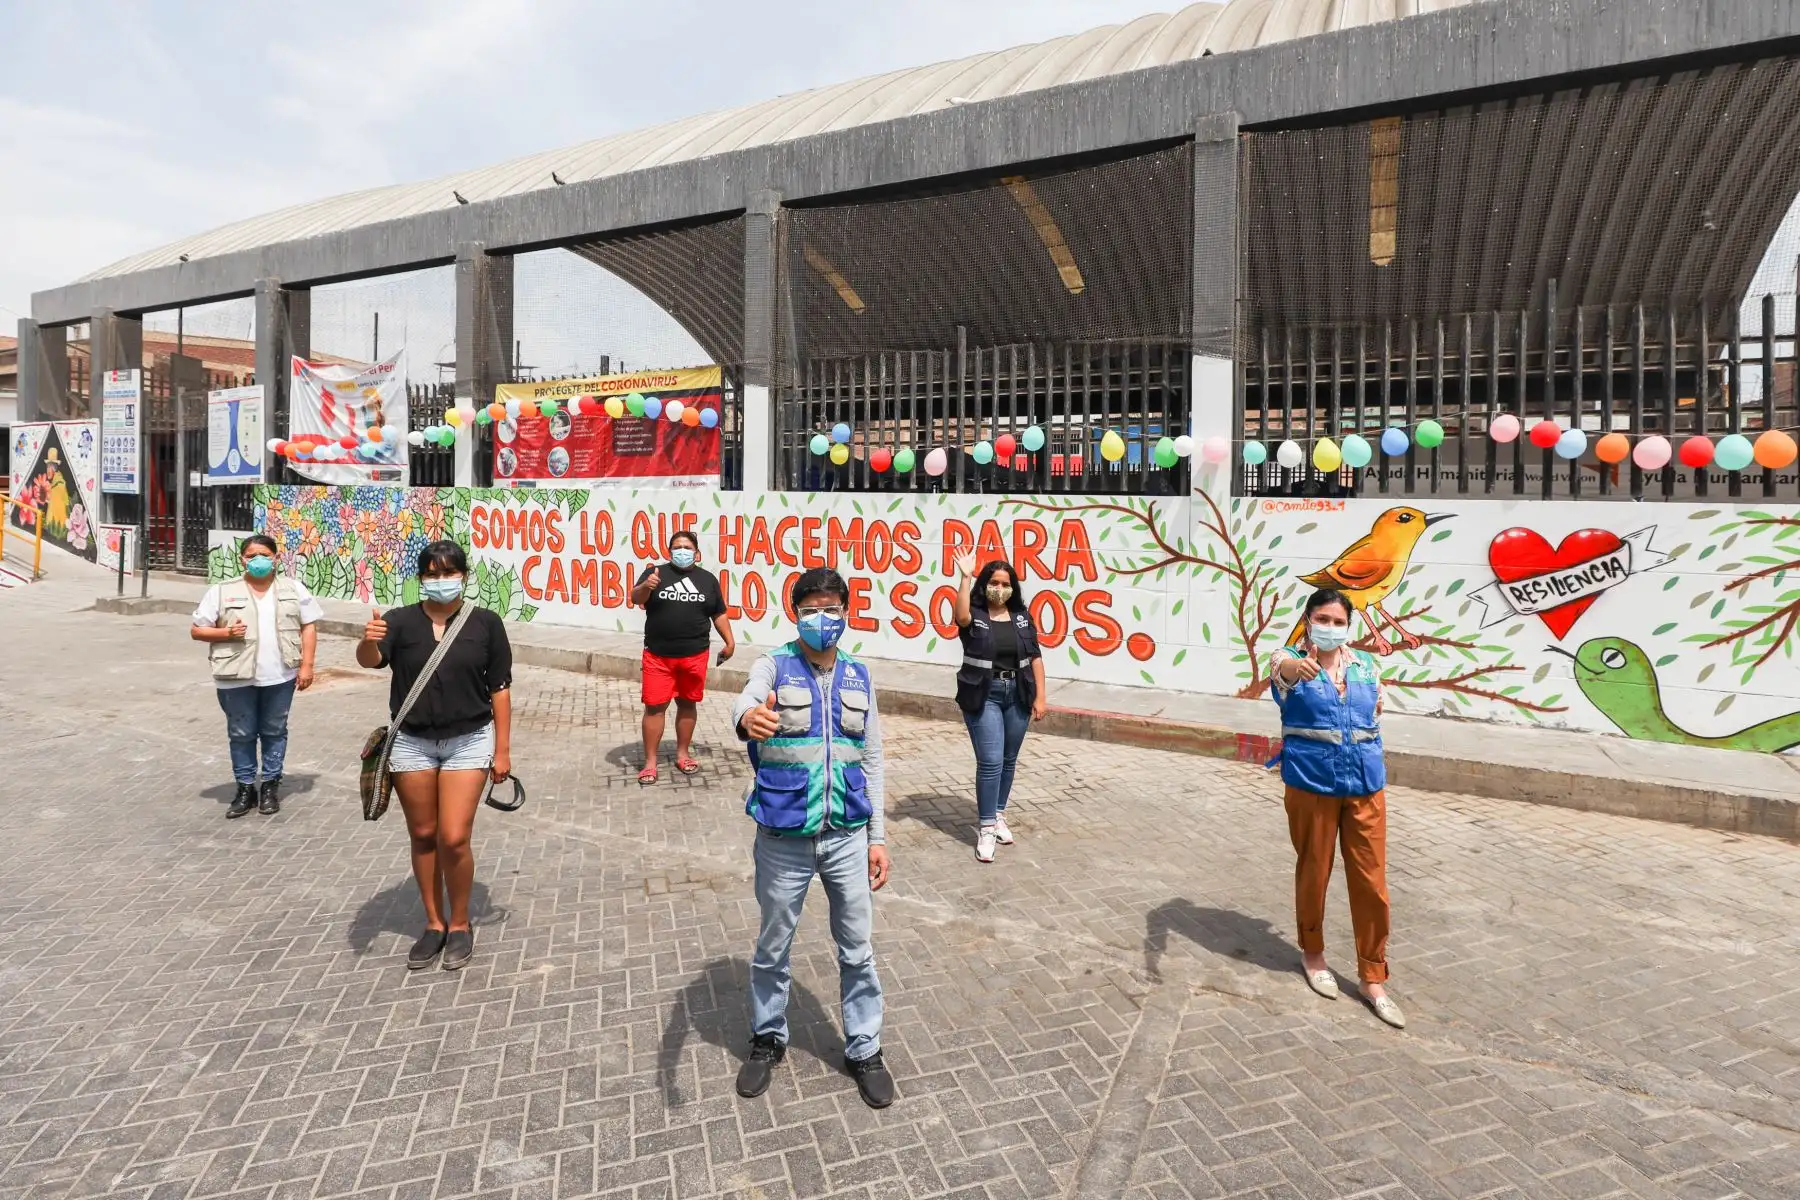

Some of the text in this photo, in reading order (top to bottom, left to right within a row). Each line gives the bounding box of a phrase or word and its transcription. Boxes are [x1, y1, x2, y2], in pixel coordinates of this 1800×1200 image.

[584, 382, 600, 393] DEL
[601, 375, 678, 392] CORONAVIRUS
[1365, 467, 1406, 482] Aud
[1417, 467, 1516, 481] Hmanitria
[471, 505, 566, 554] SOMOS
[580, 509, 615, 557] LO
[718, 514, 922, 576] HACEMOS
[942, 518, 1099, 582] PARA
[658, 590, 706, 602] adidas
[1508, 556, 1627, 605] RESILIENCIA
[521, 555, 655, 609] CAMBI
[719, 569, 768, 623] LO
[889, 580, 1155, 662] SOOS.
